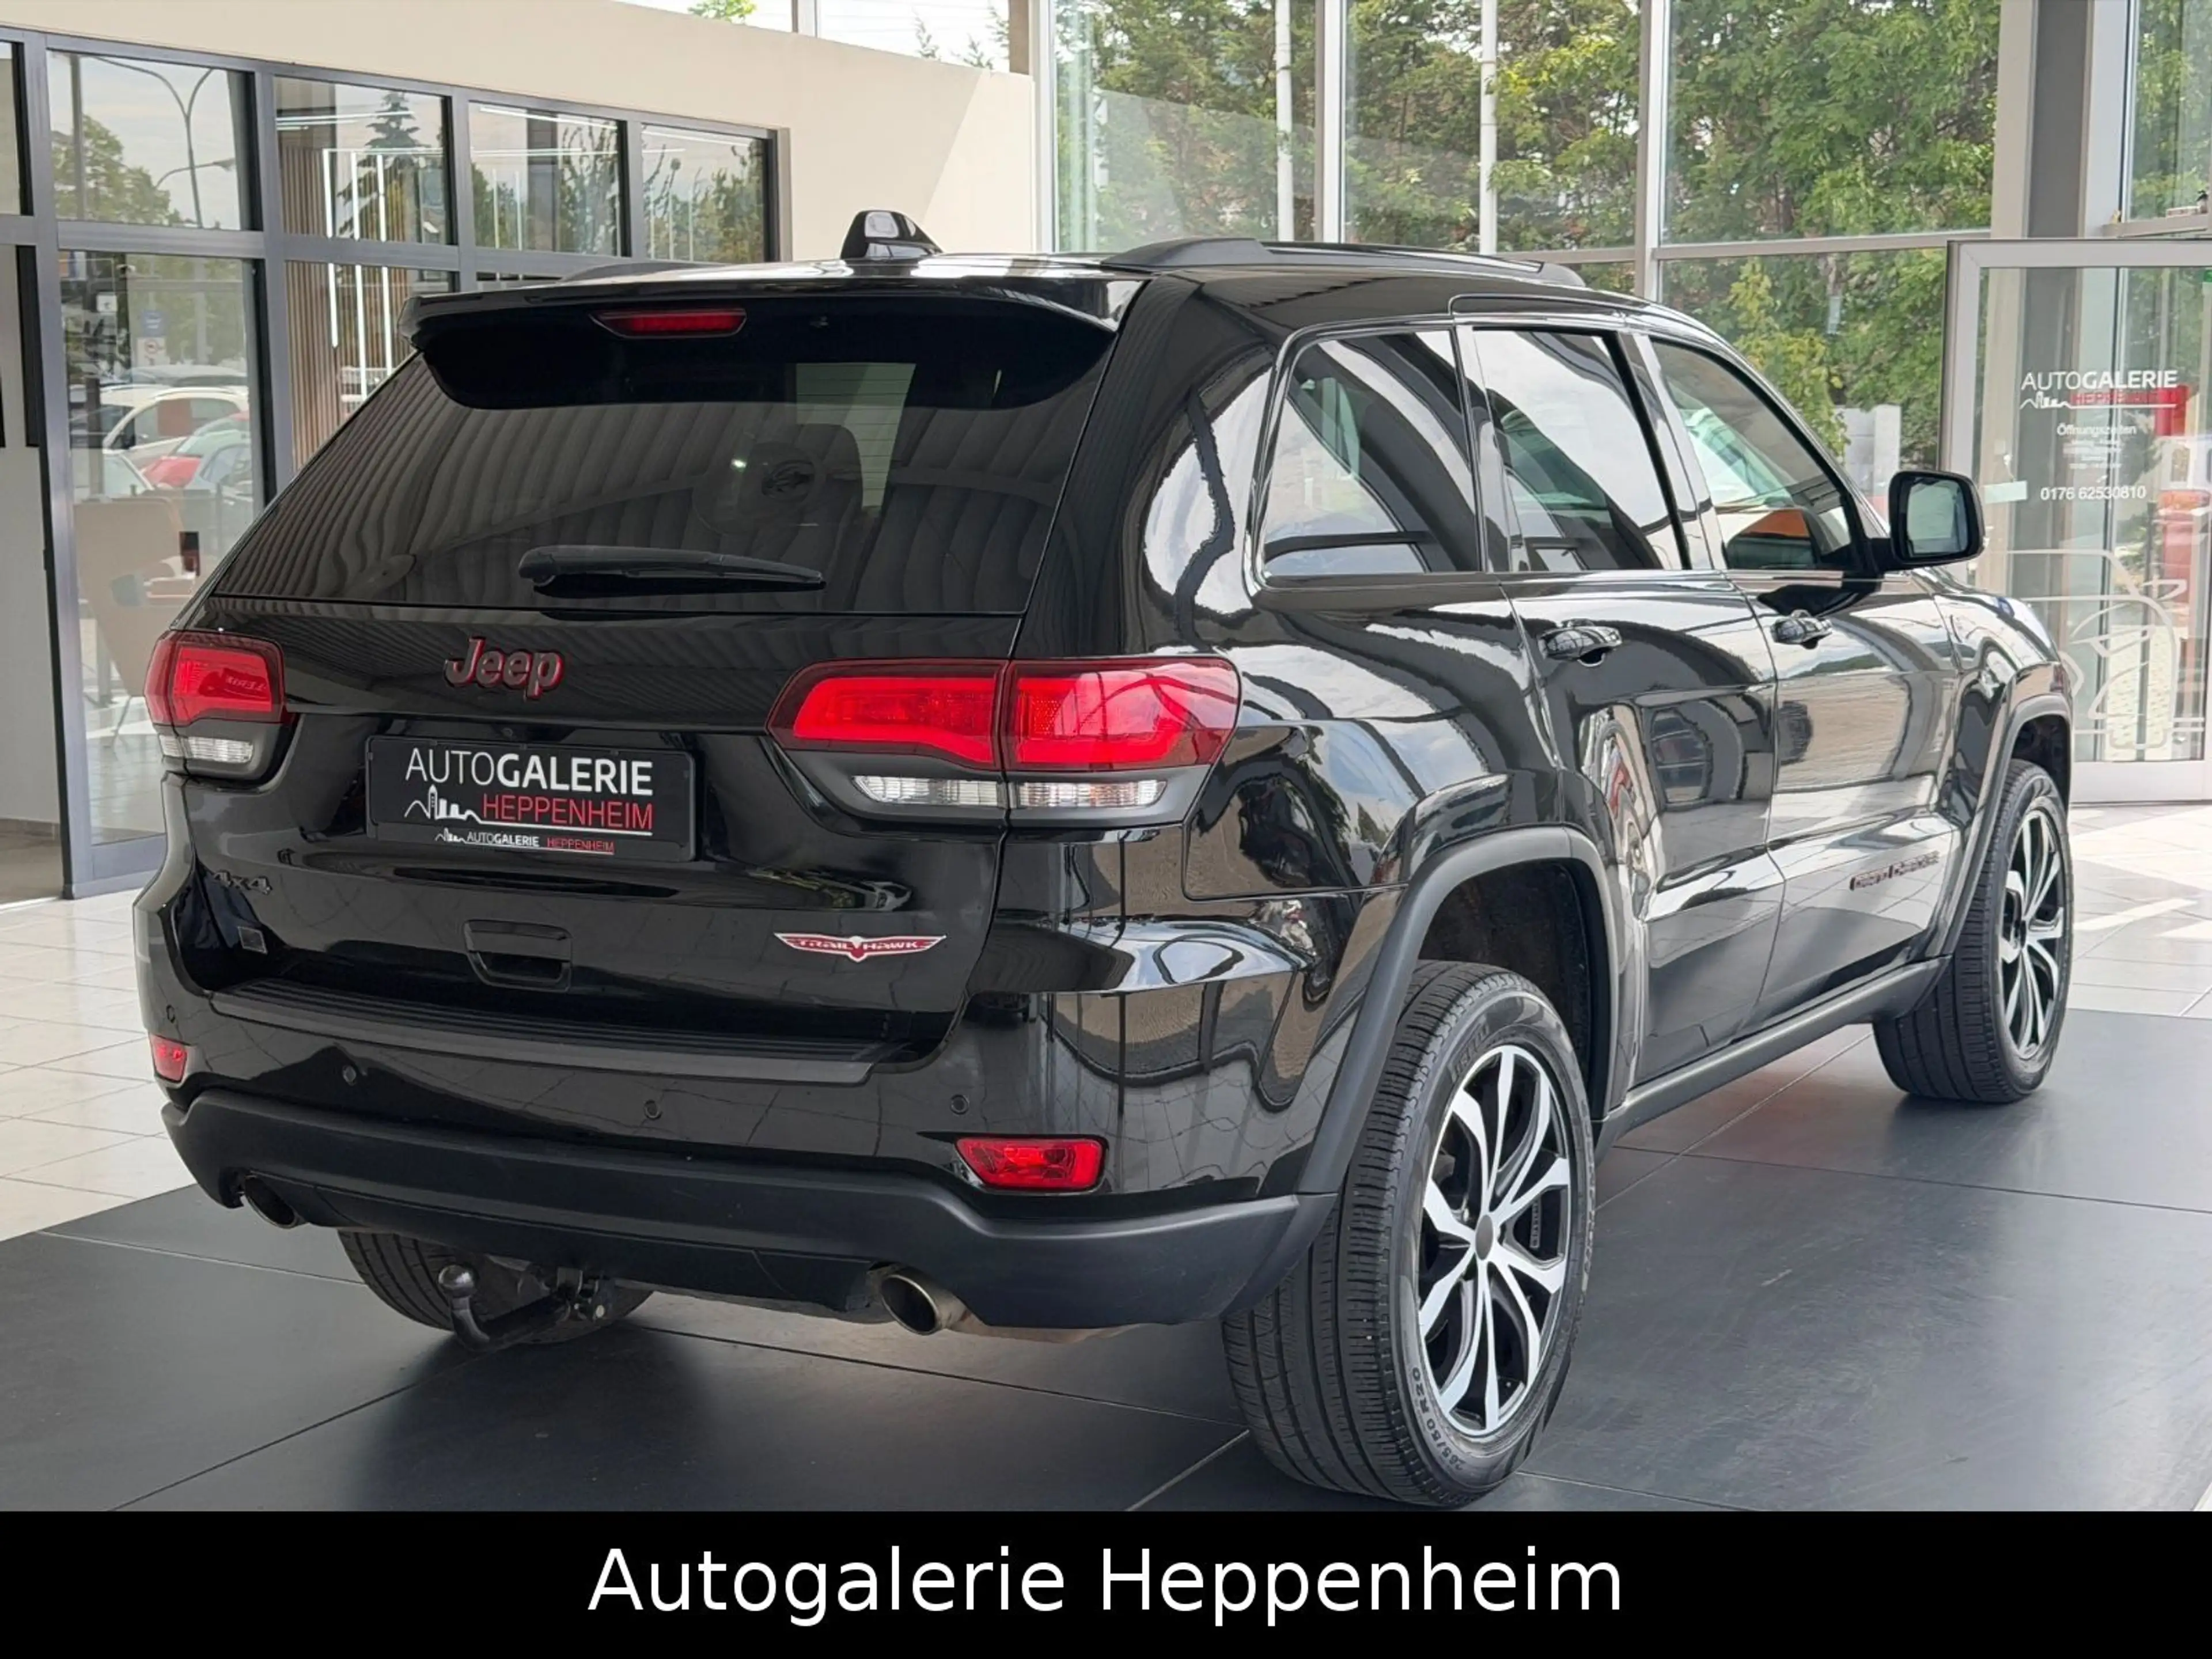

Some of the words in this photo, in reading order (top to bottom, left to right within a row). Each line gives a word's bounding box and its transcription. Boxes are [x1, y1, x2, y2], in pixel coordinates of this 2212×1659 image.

[2021, 370, 2179, 391] AUTOGALERIE
[2040, 487, 2075, 501] 0176
[2078, 485, 2147, 500] 62530810
[444, 637, 565, 700] Jeep
[405, 748, 653, 796] AUTOGALERIE
[483, 793, 653, 830] HEPPENHEIM
[467, 831, 539, 847] AUTOGALERIE
[547, 837, 615, 851] HEPPENHEIM
